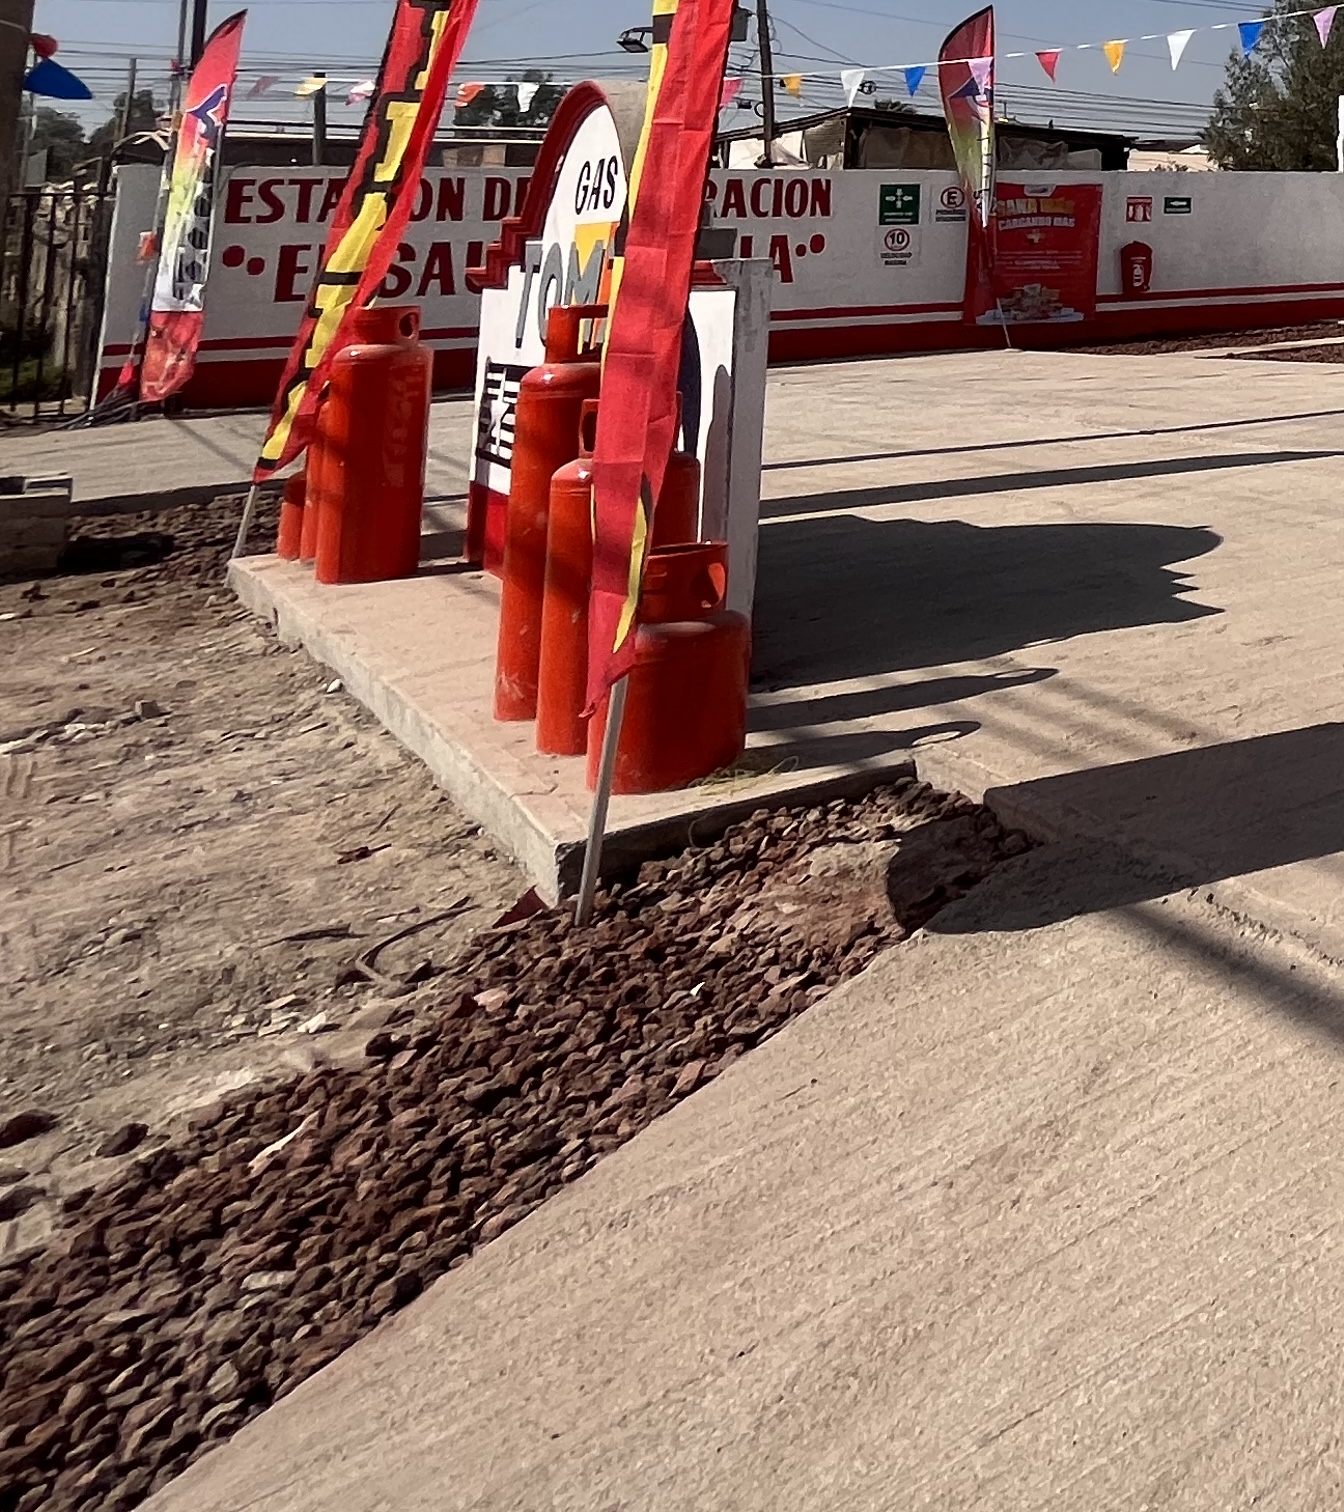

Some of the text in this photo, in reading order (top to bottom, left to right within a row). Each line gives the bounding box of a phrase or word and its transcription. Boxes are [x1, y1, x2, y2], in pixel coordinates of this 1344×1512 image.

[224, 177, 465, 224] ESTAON
[575, 155, 618, 215] GAS
[889, 231, 905, 245] 10
